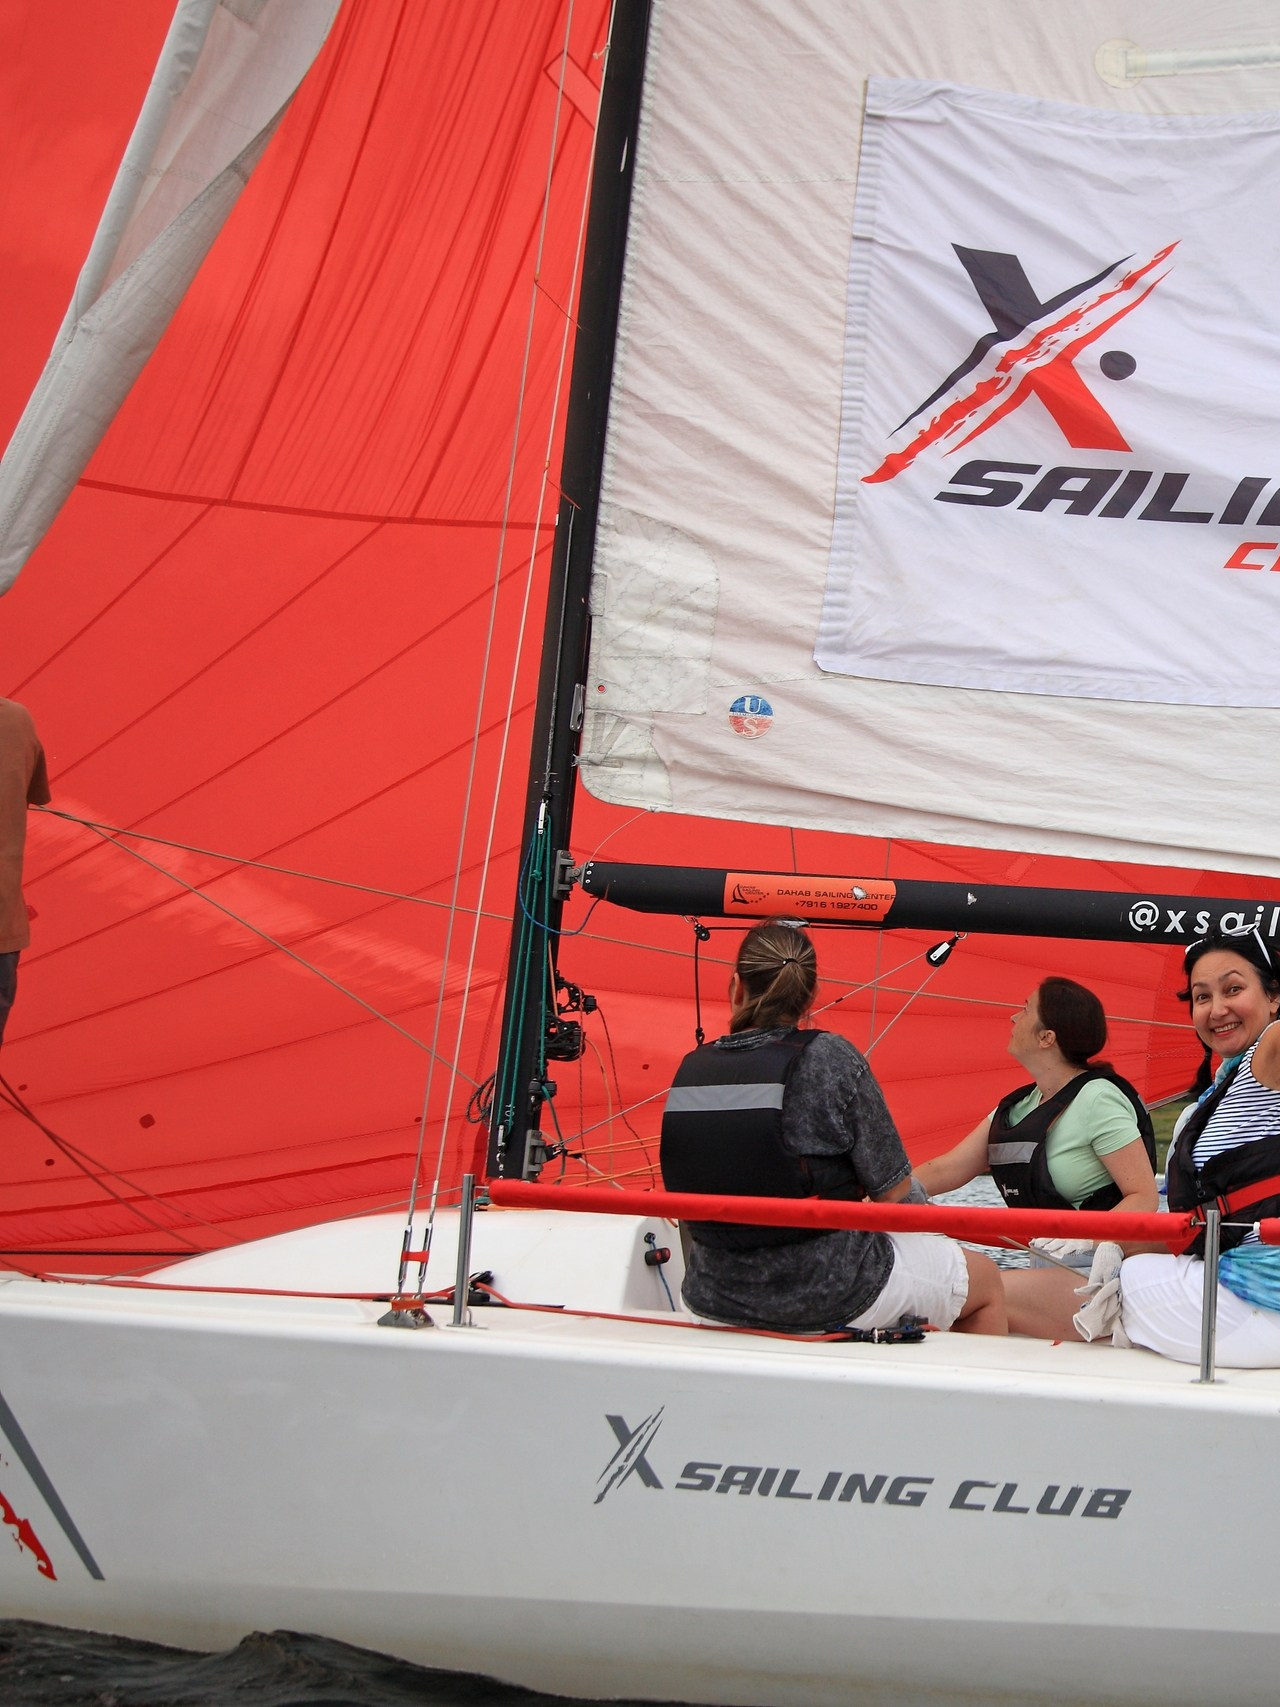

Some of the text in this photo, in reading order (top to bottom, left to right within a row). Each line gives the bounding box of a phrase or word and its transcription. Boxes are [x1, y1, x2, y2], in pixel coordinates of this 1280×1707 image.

[777, 889, 811, 897] DAHAB
[814, 891, 853, 899] SAILING
[795, 900, 878, 911] +7916 1927400
[675, 1461, 935, 1508] SAILING
[948, 1480, 1132, 1519] CLUB
